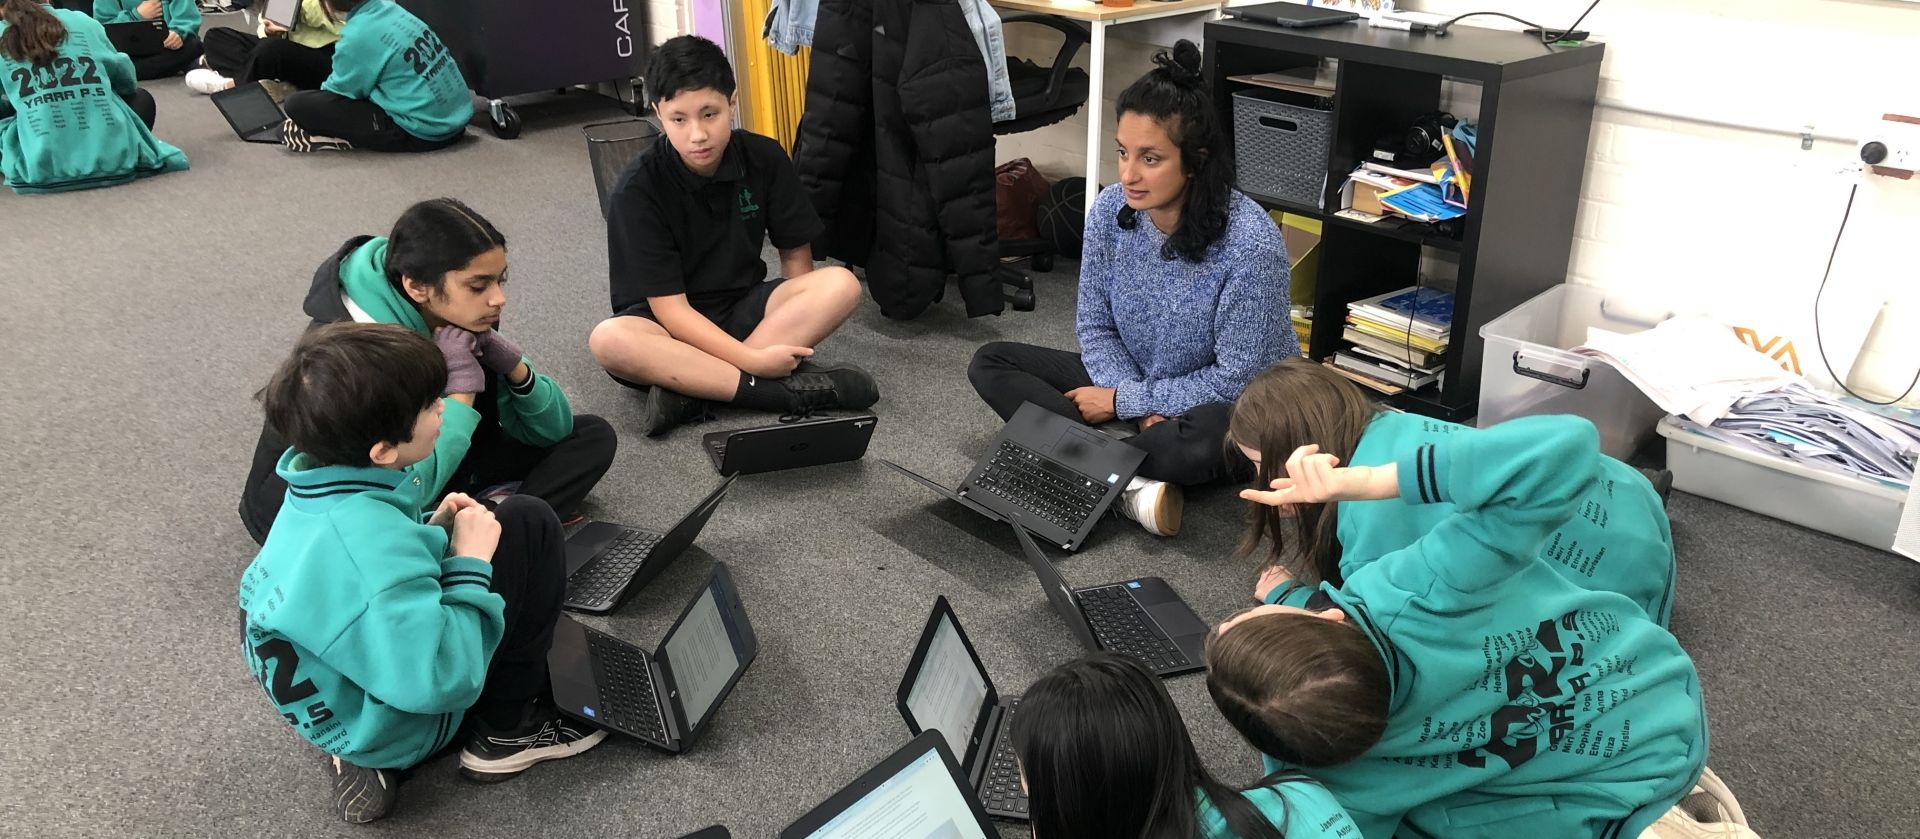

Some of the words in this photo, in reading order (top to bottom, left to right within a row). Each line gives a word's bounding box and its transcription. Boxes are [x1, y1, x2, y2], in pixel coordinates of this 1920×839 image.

[11, 56, 102, 98] 2022
[24, 90, 76, 109] YARRA
[1562, 541, 1577, 565] Sophie
[1570, 549, 1583, 569] Ethan
[1587, 547, 1606, 578] Christian
[1609, 689, 1619, 711] arry
[318, 729, 348, 749] oward
[1418, 716, 1432, 743] Mieka
[1477, 721, 1486, 739] Zoe
[1575, 722, 1592, 755] Sophie
[1618, 719, 1631, 753] hristian
[331, 740, 351, 755] Zach
[1589, 730, 1604, 757] Ethan
[1603, 736, 1616, 759] Eliza
